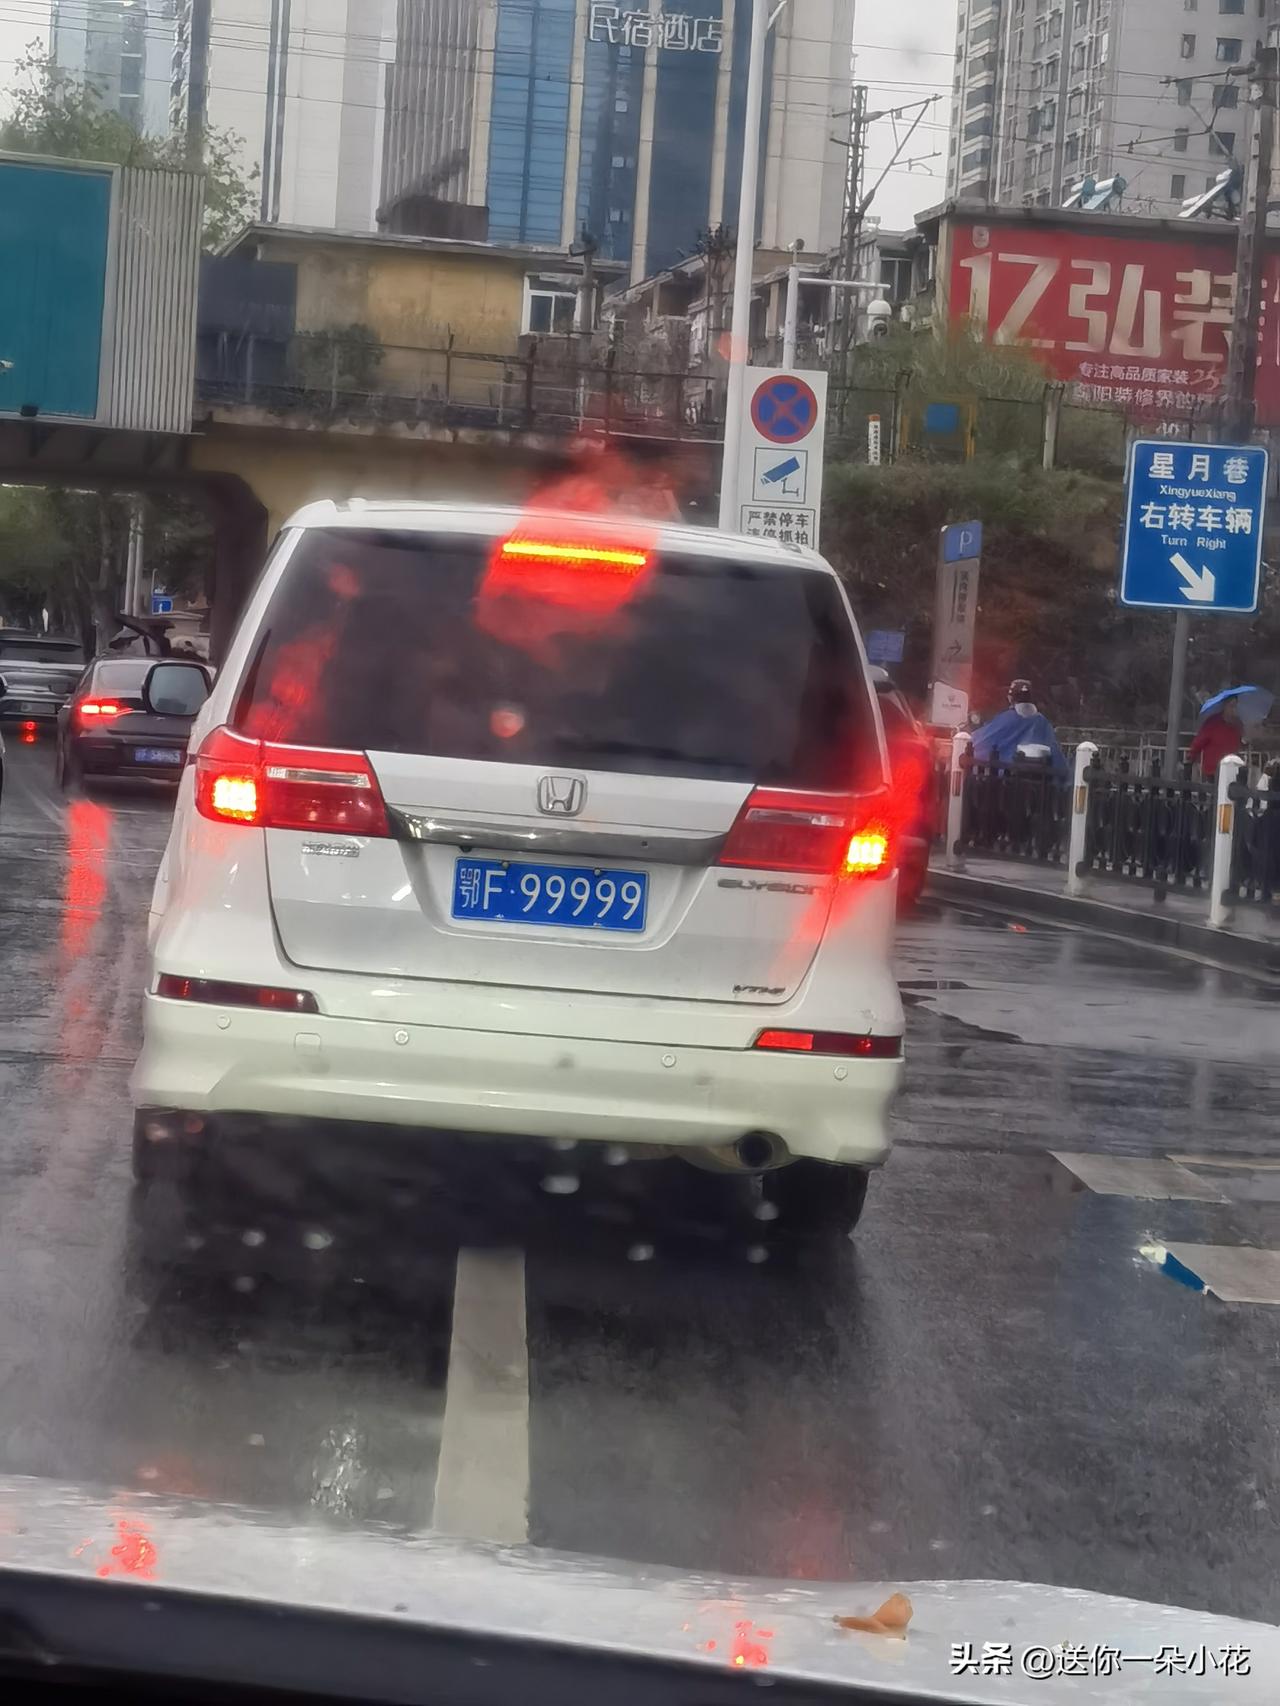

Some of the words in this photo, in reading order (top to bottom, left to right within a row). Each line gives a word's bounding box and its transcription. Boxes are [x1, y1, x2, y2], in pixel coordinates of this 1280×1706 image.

[588, 4, 724, 52] 民宿酒店
[1149, 452, 1249, 484] 星月巷
[747, 510, 809, 528] 严禁停车
[1139, 501, 1253, 535] 右转车辆
[1161, 534, 1188, 547] Turn
[1196, 536, 1226, 551] Right
